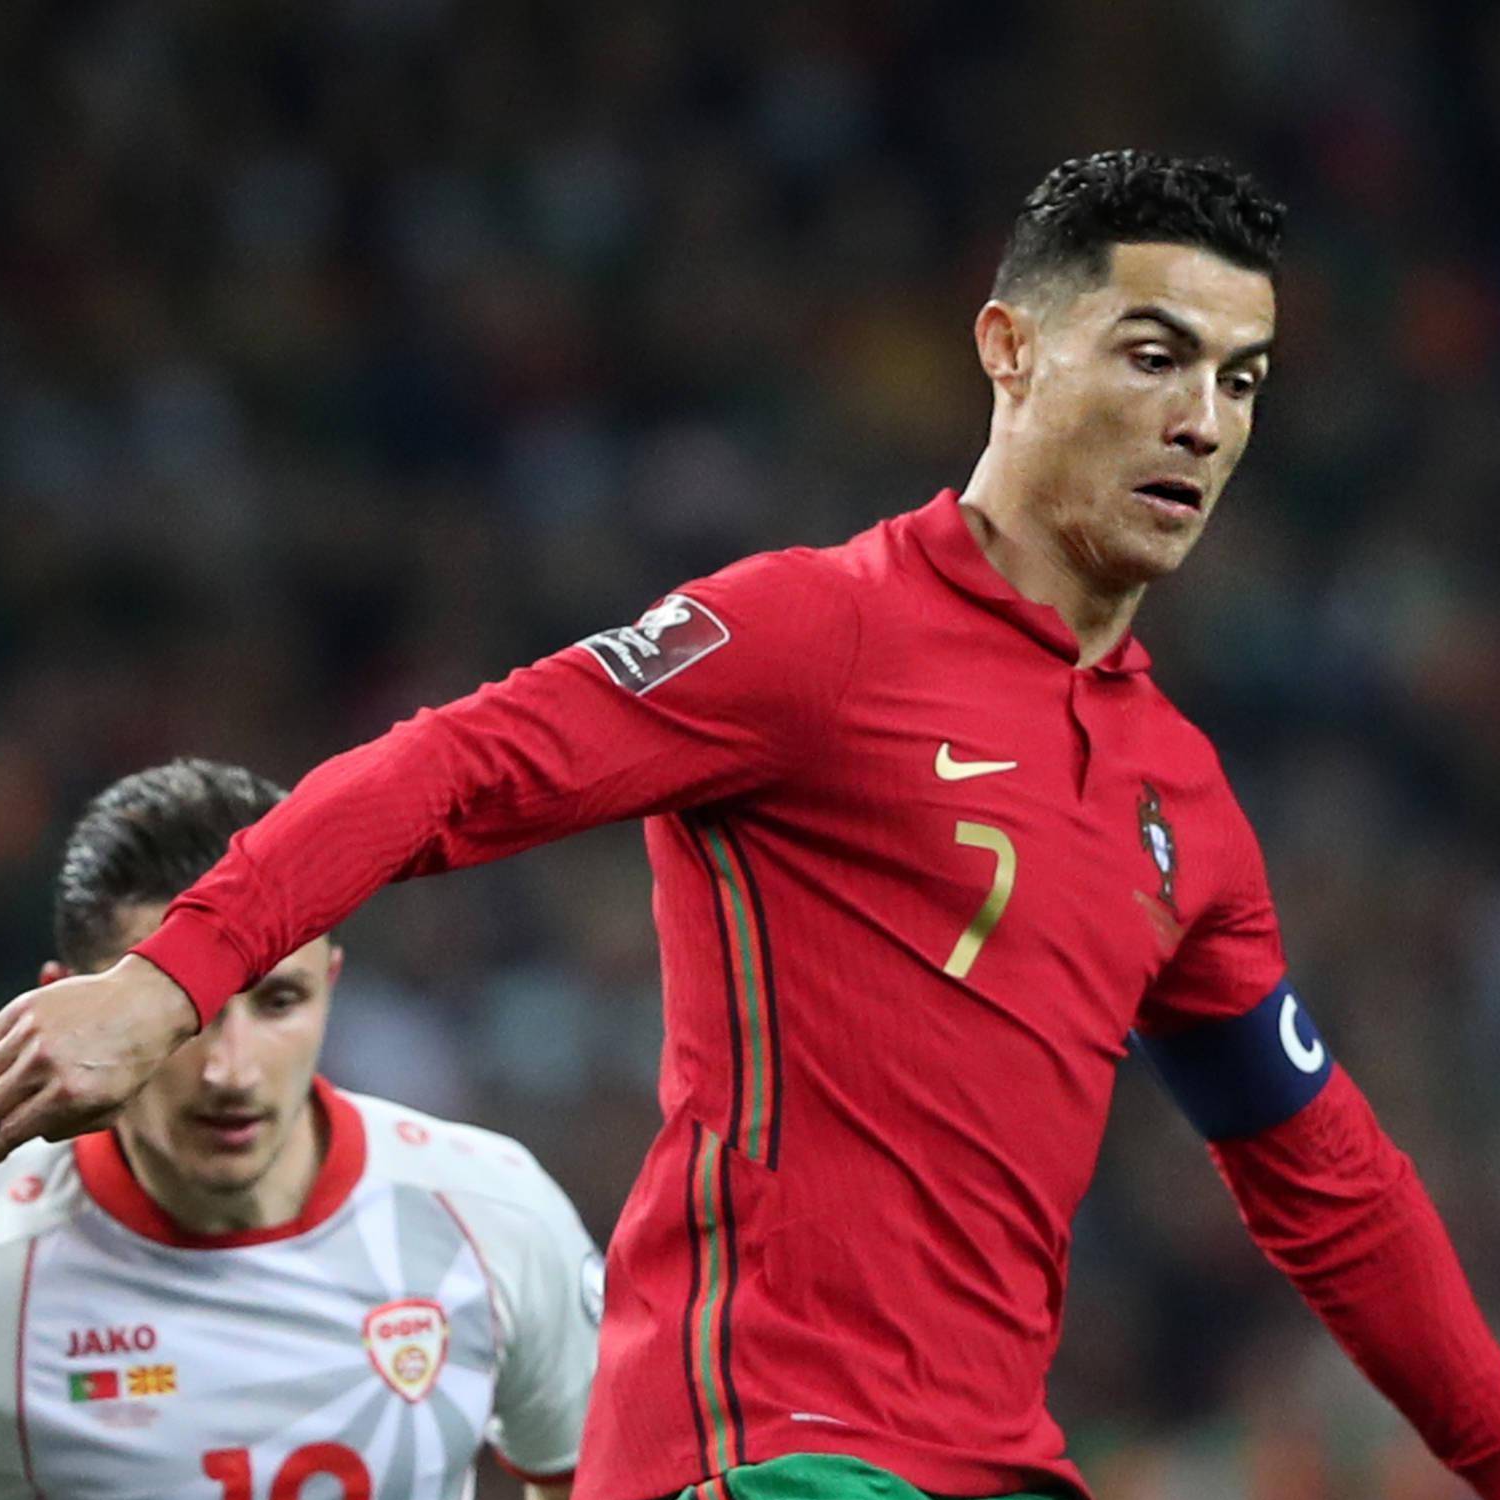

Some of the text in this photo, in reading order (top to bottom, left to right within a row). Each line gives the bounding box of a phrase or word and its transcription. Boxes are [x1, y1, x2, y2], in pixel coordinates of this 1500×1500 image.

[943, 820, 1018, 979] 7
[1278, 993, 1325, 1074] C
[65, 1325, 157, 1358] JAKO
